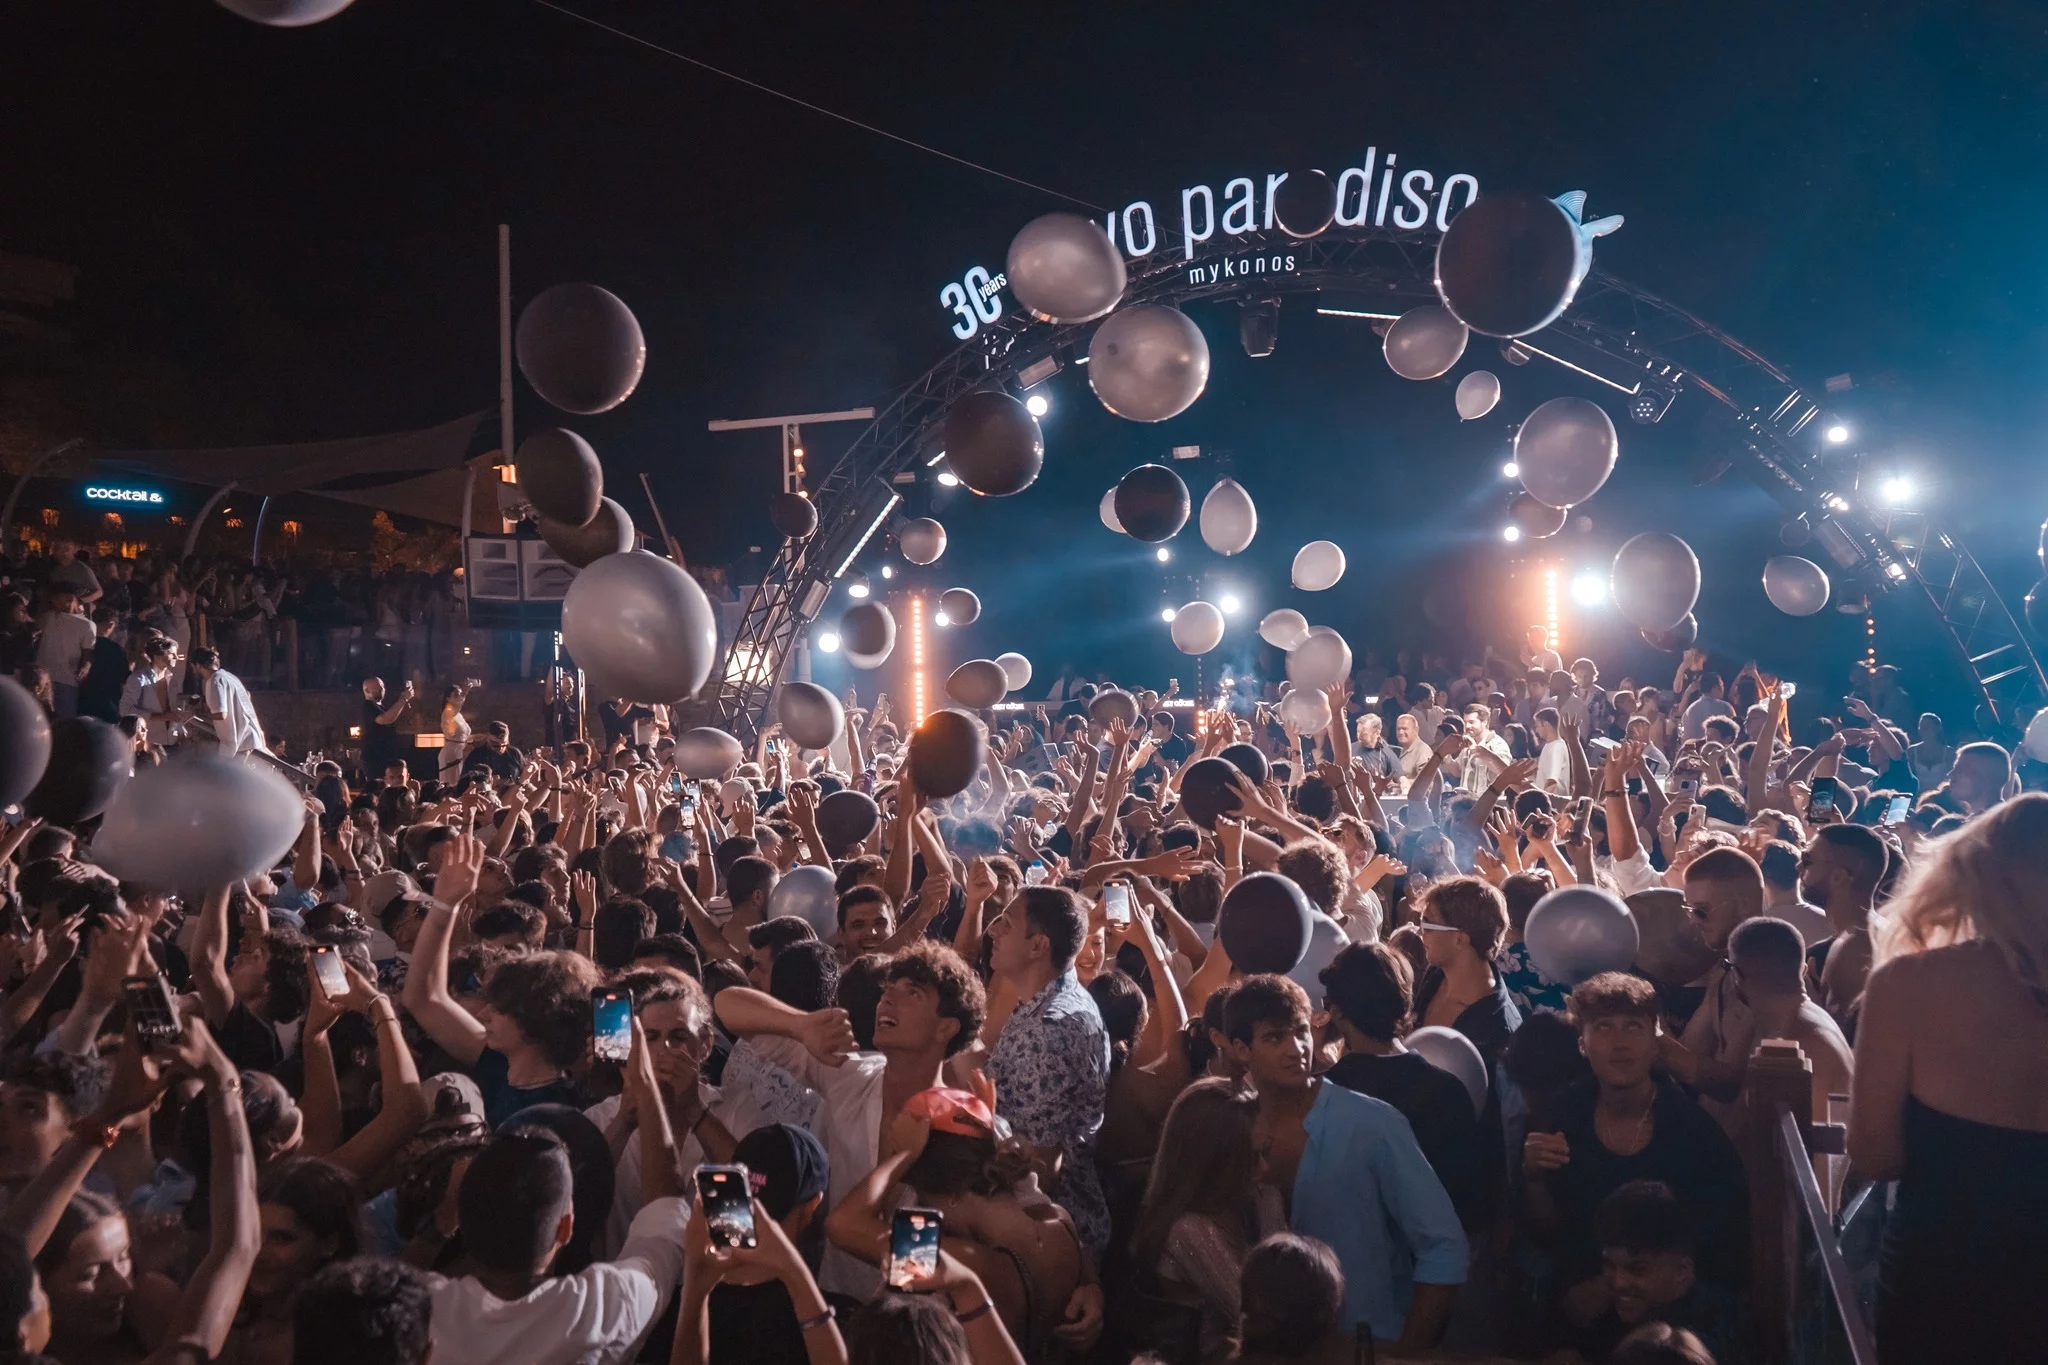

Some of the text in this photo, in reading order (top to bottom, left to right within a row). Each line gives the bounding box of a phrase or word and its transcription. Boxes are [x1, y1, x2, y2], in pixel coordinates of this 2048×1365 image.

[1182, 146, 1479, 261] pardiso
[940, 265, 1007, 340] 30 years
[1189, 255, 1295, 285] mykonos
